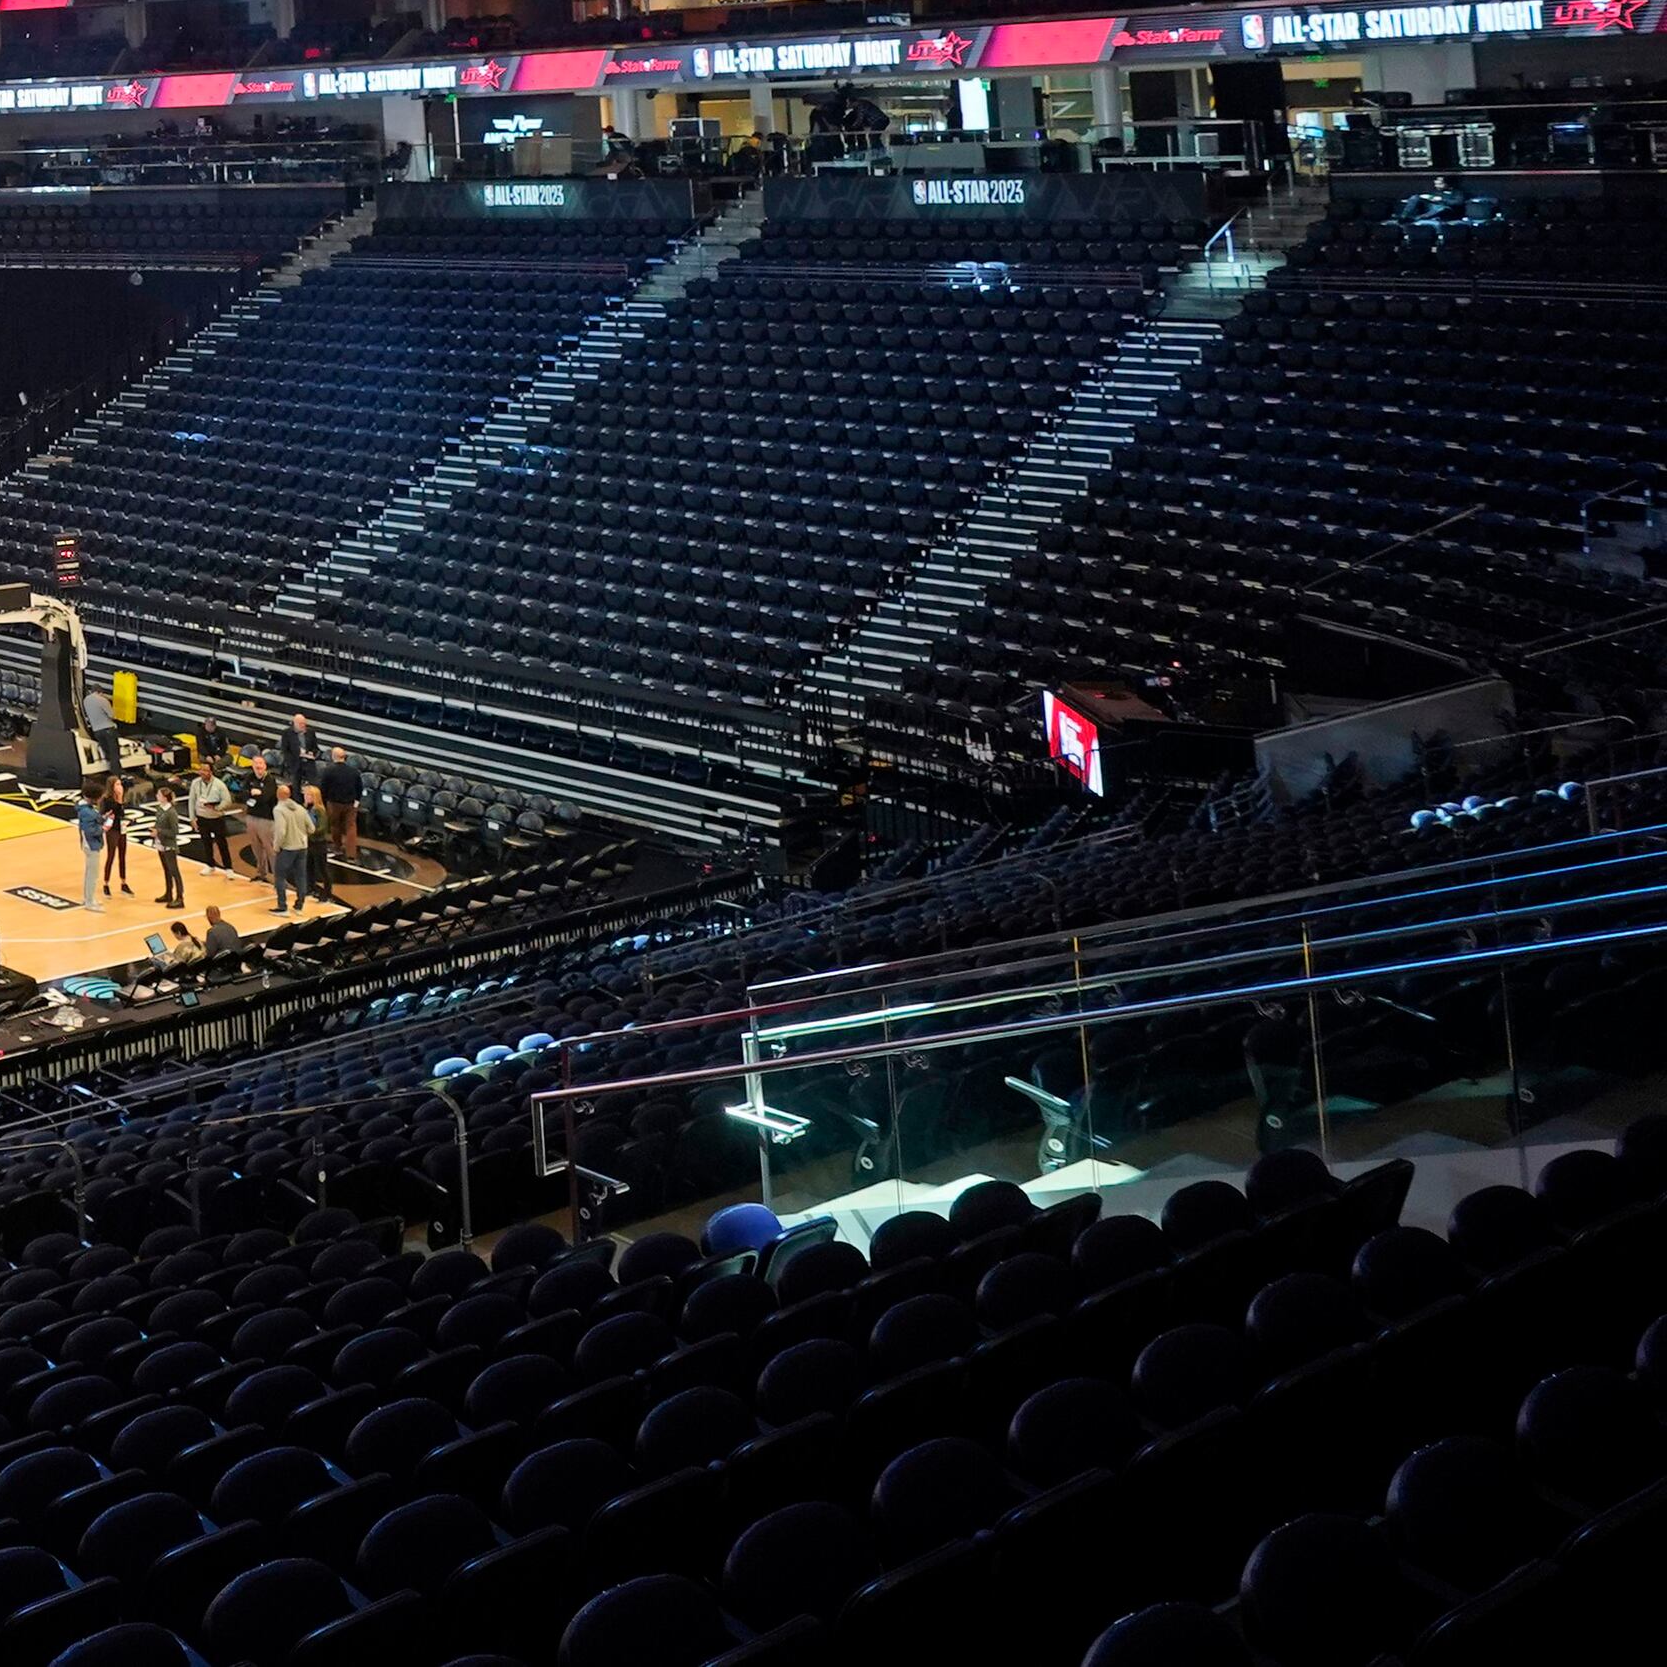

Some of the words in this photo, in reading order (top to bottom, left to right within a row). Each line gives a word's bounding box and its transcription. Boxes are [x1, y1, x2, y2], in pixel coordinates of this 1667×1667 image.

[1364, 4, 1471, 39] SATURDAY
[1475, 0, 1544, 33] NIGHT
[777, 42, 852, 70] SATURDAY
[853, 39, 901, 66] NIGHT
[367, 68, 422, 92] SATURDAY
[422, 65, 457, 89] NIGHT
[16, 86, 70, 108] SATURDAY
[70, 85, 104, 106] NIGHT
[539, 185, 564, 206] 2023
[990, 179, 1024, 204] 2023
